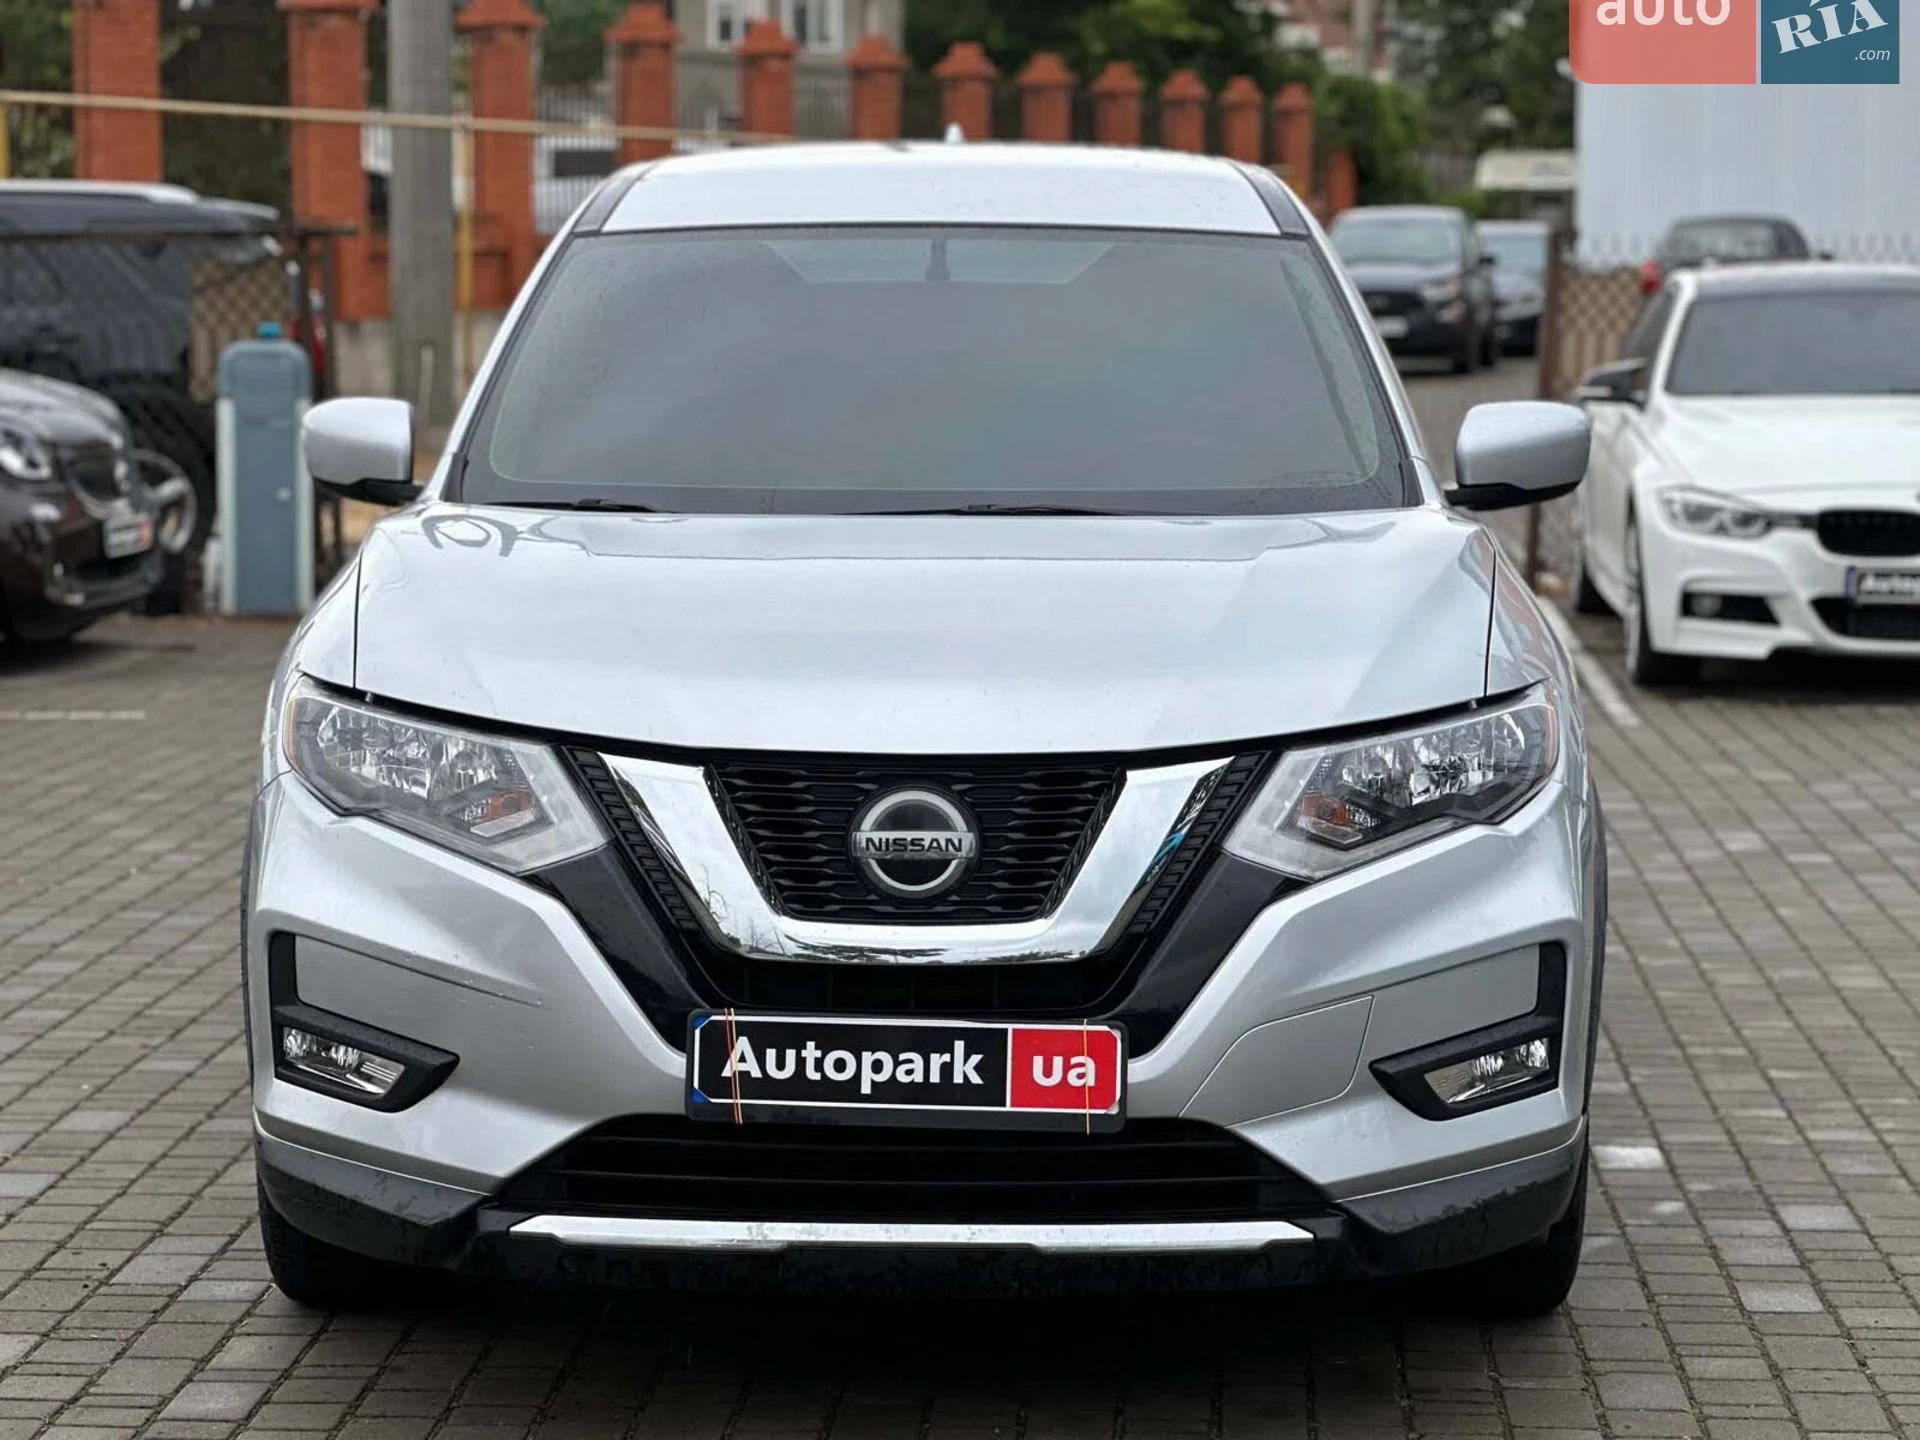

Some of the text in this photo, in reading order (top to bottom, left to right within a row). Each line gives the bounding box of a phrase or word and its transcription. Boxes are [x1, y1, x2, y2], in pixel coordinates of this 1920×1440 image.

[865, 837, 962, 853] NISSAN
[720, 1036, 1096, 1094] Autopark ua
